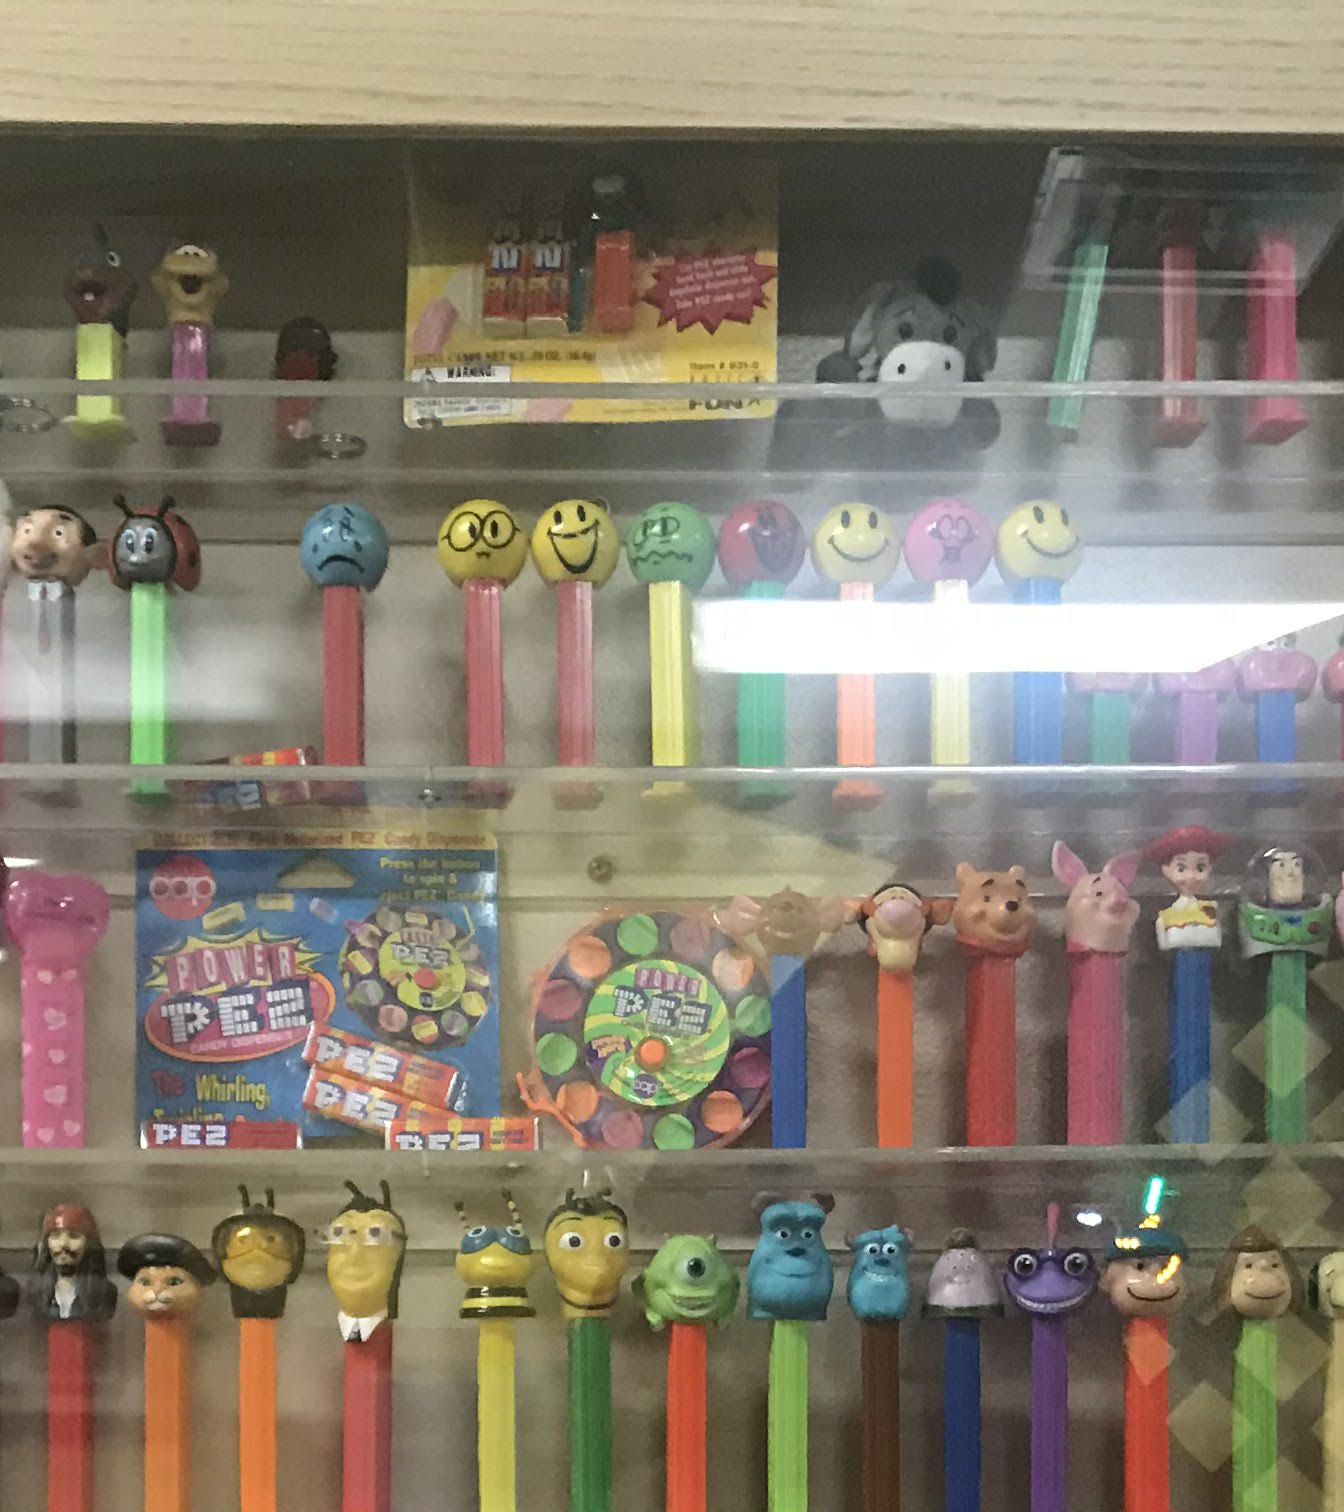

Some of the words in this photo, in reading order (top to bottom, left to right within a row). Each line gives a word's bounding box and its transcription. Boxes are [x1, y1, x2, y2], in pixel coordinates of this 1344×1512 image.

[175, 943, 293, 991] POWER
[391, 942, 451, 967] PEZ
[159, 985, 307, 1044] PEZ
[614, 987, 708, 1036] PEZ
[315, 1034, 402, 1083] PEZ
[313, 1080, 400, 1128] PEZ
[152, 1123, 228, 1147] PEZ
